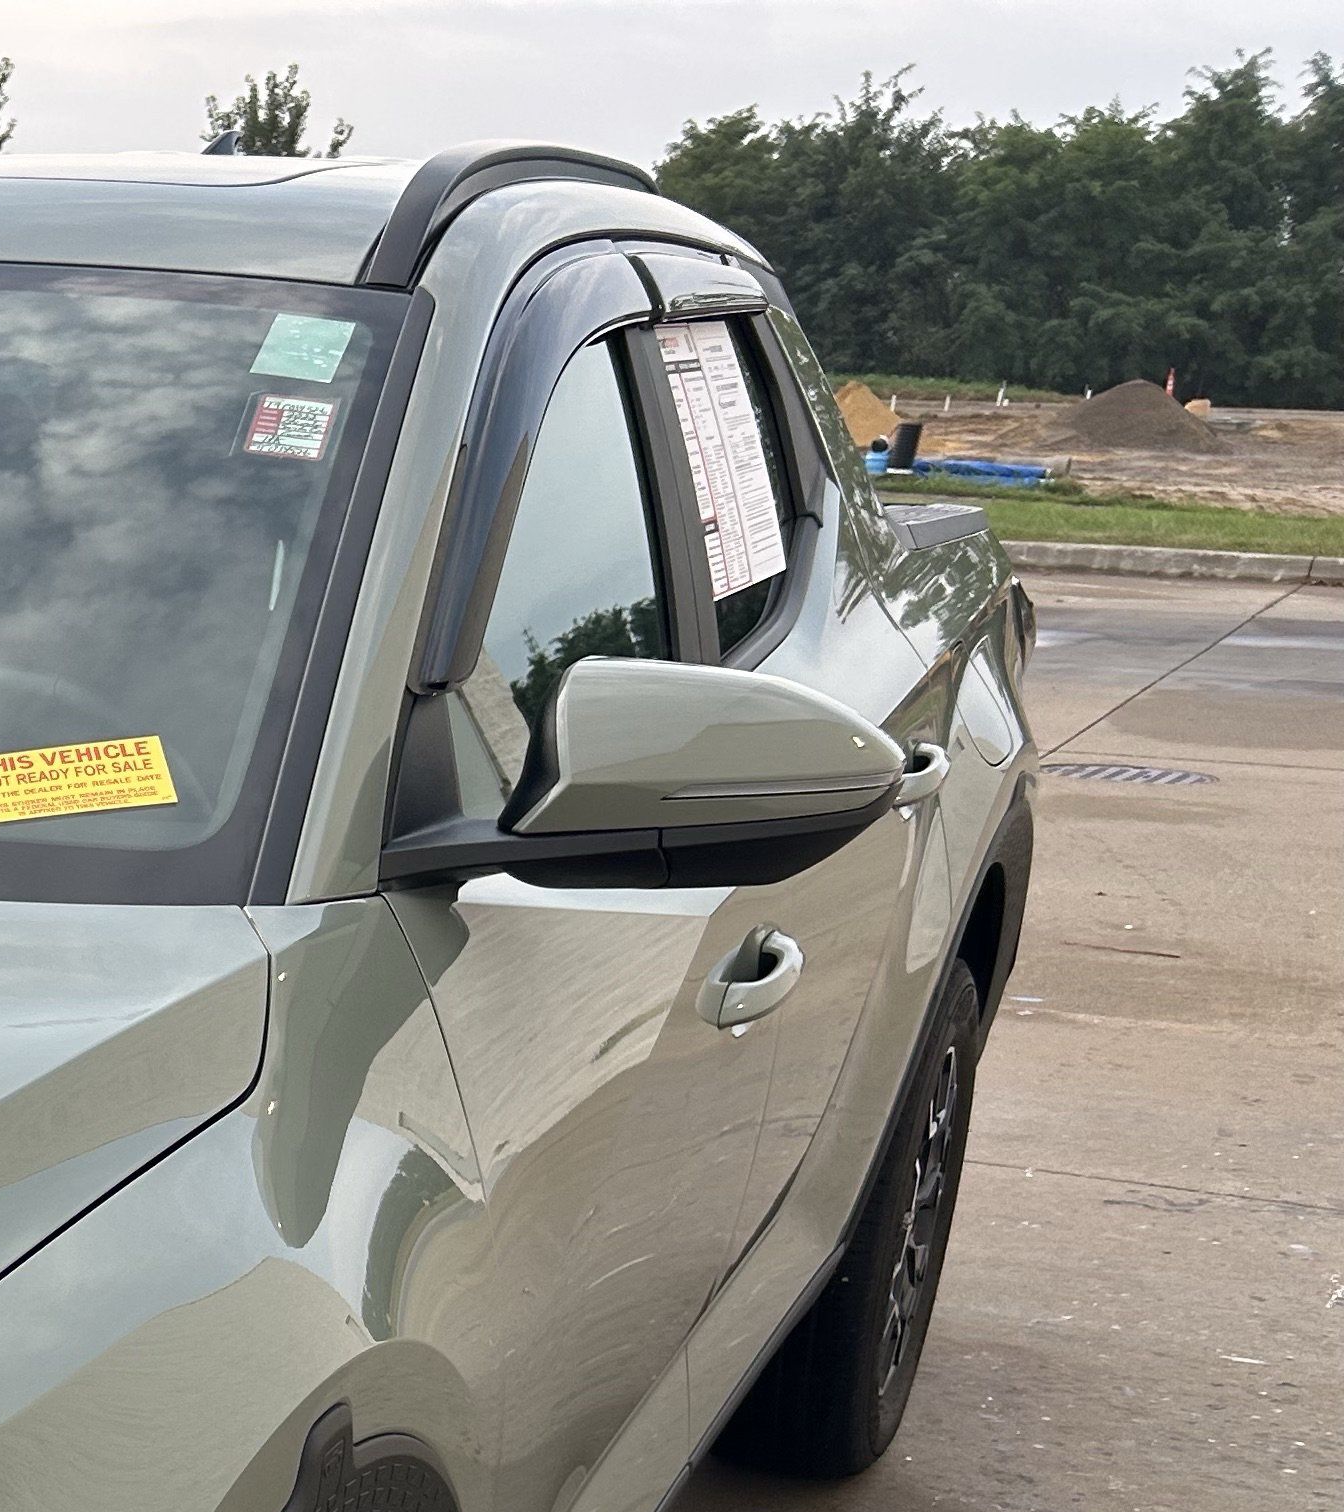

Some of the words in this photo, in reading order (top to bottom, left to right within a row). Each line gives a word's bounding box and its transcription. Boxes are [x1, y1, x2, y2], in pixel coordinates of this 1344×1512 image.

[39, 741, 151, 766] VEHICLE
[16, 768, 70, 785] READY
[74, 763, 108, 778] FOR
[112, 758, 154, 773] SALE
[1, 790, 21, 798] THE
[23, 785, 63, 795] DEALER
[67, 782, 89, 790] FOR
[92, 776, 132, 787] RESALE
[137, 773, 162, 782] DATE
